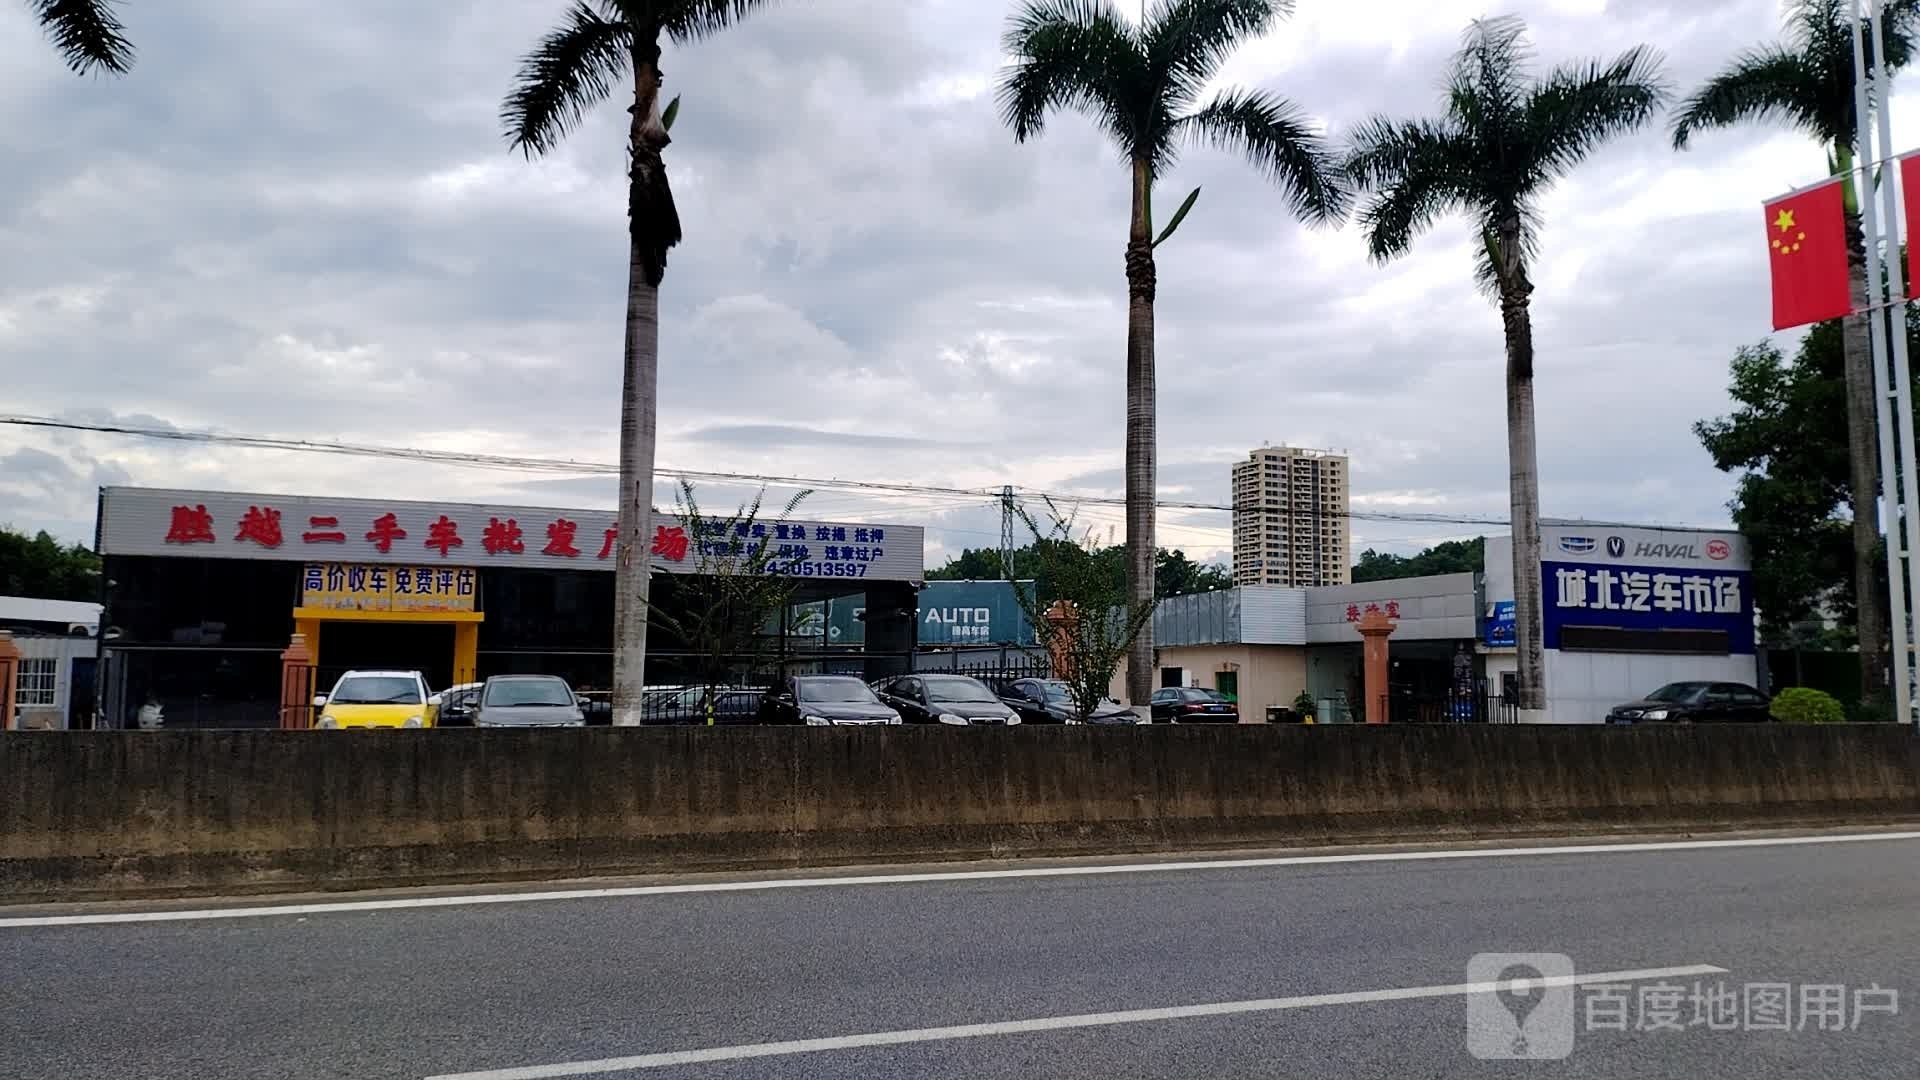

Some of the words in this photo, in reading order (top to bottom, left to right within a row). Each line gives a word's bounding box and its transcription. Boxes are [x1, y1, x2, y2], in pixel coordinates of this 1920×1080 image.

[777, 525, 806, 540] 置换
[816, 526, 846, 542] 按揭
[855, 528, 884, 543] 抵押
[825, 546, 883, 562] 违章过户
[1634, 543, 1700, 559] HAVAL
[305, 565, 388, 593] 高价收车
[394, 567, 474, 595] 免费评估
[1555, 568, 1742, 614] 城北汽车市场
[924, 607, 990, 624] AUTO
